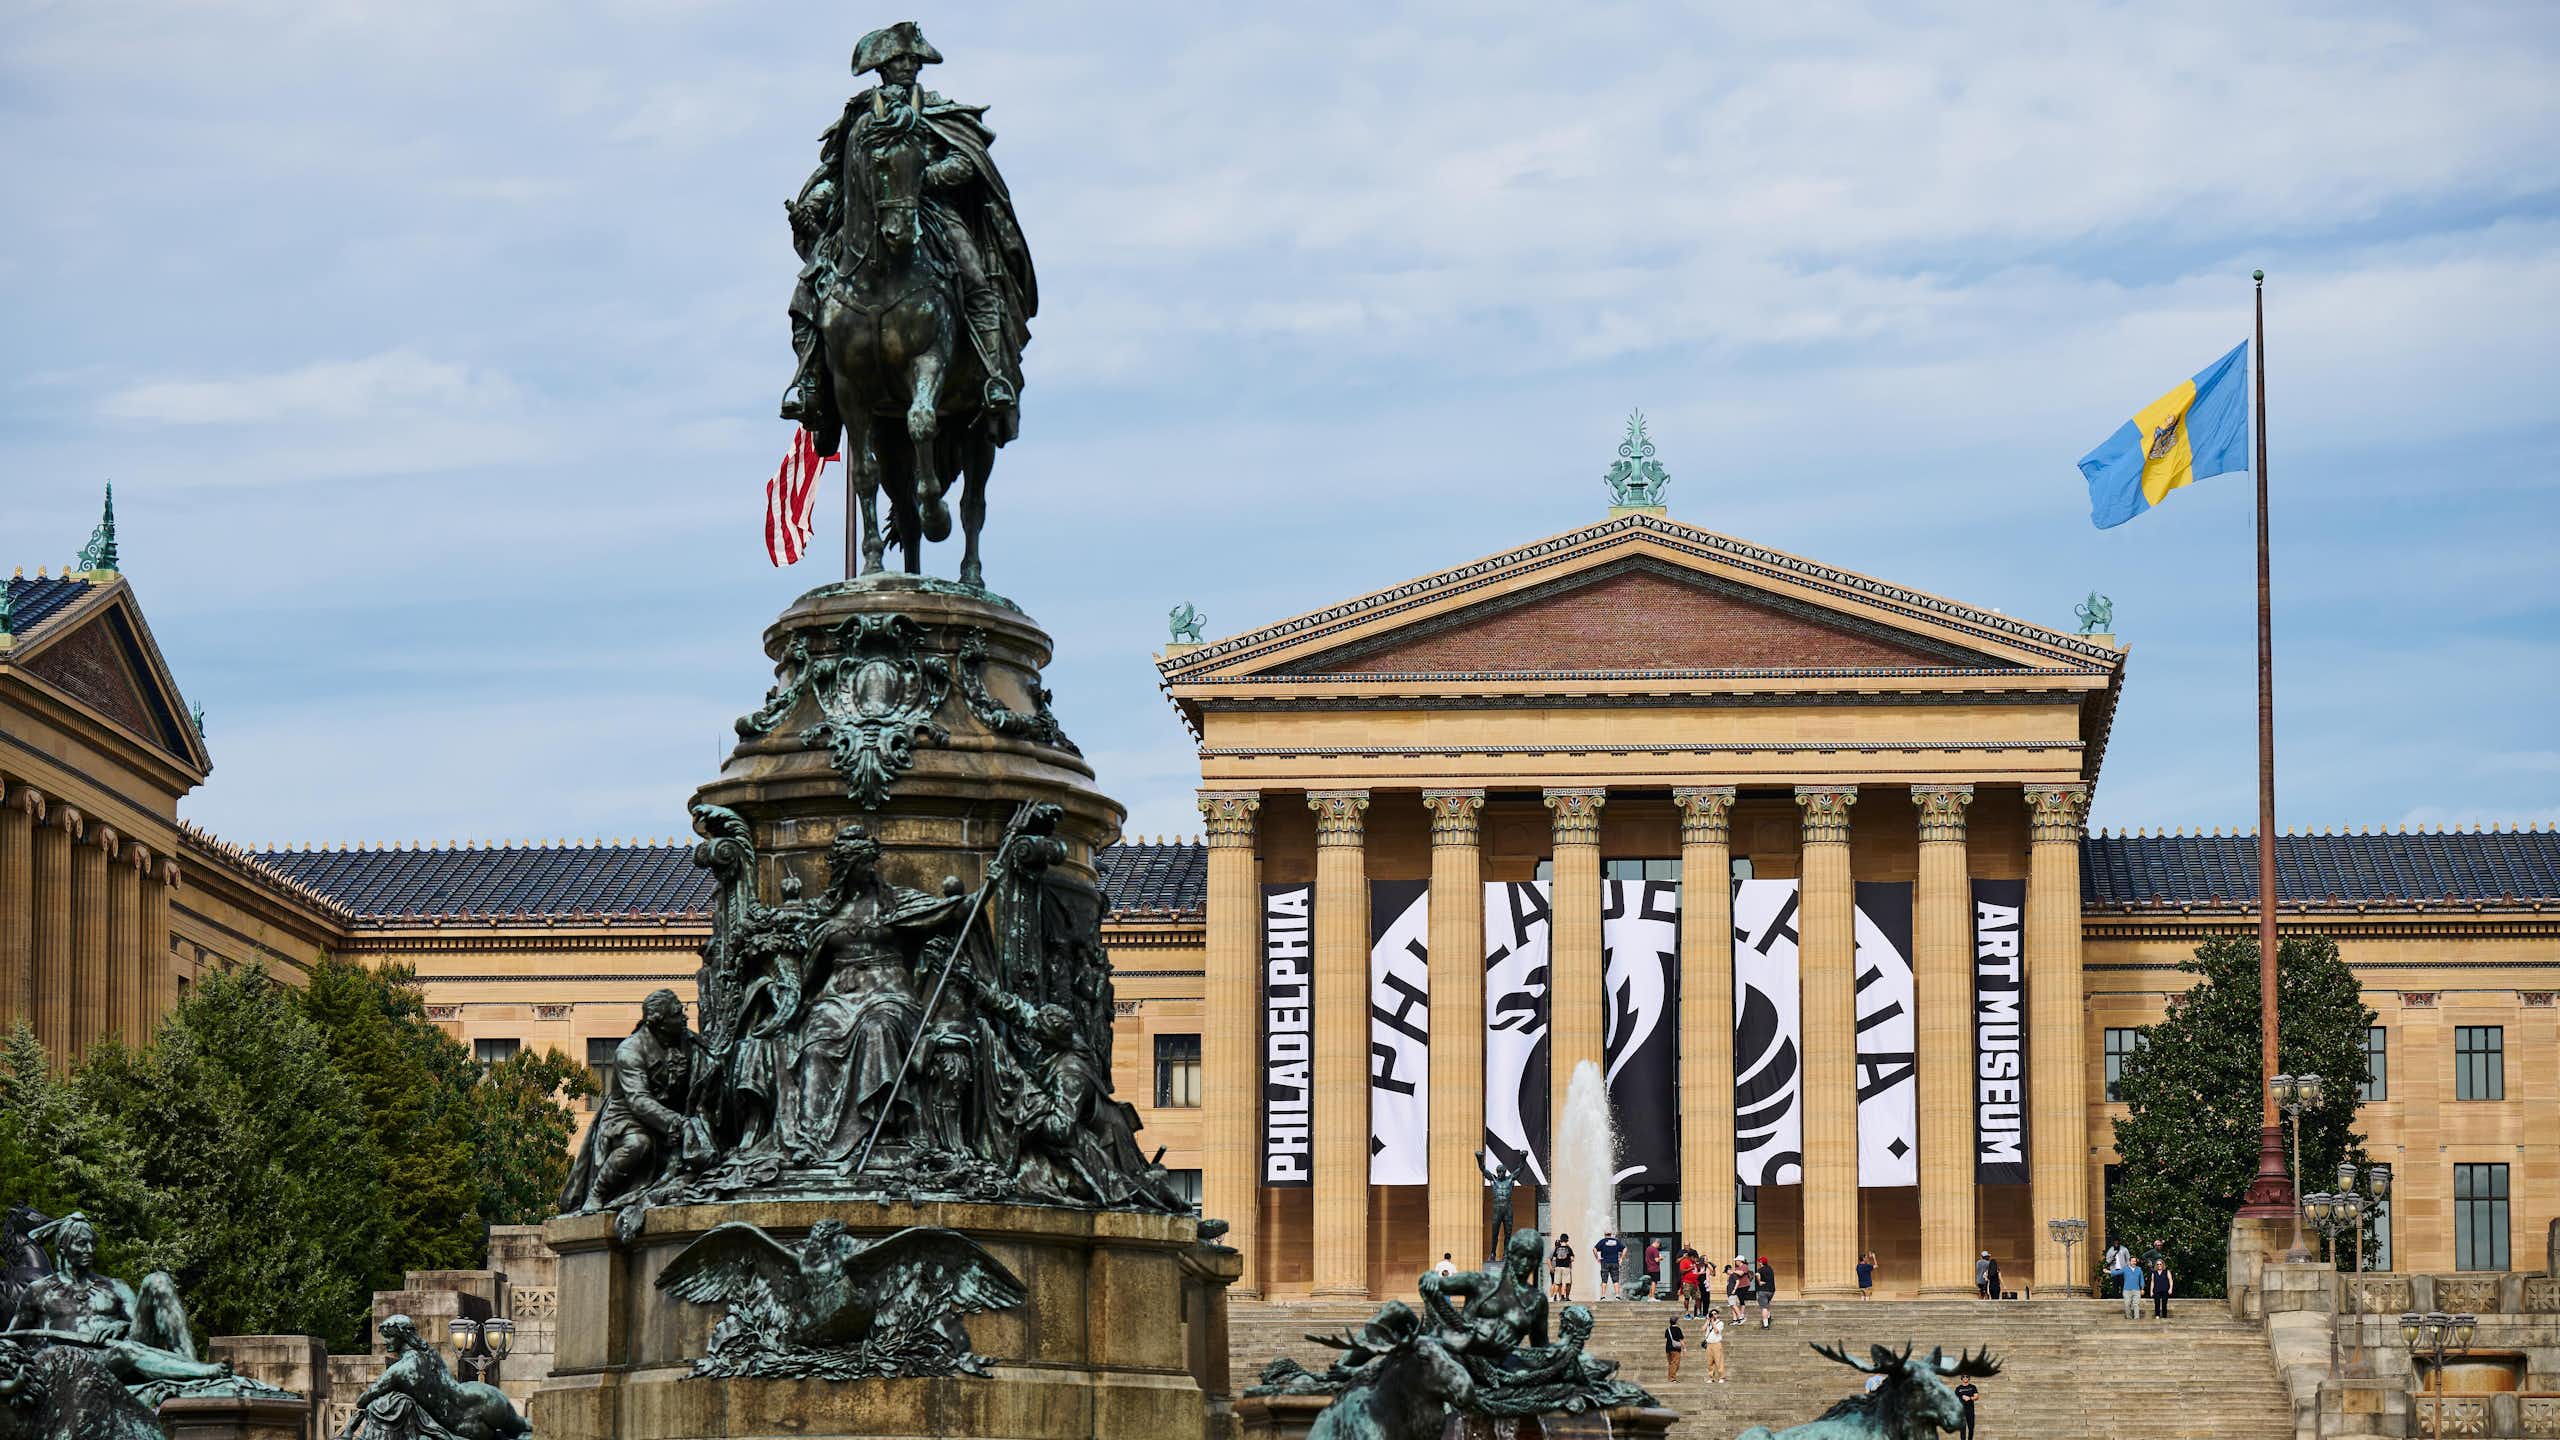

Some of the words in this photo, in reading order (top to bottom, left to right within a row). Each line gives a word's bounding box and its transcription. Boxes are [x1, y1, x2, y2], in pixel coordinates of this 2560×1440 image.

[1977, 900, 2019, 984] ART
[1267, 887, 1309, 1182] PHILADELPHIA
[1979, 989, 2022, 1165] MUSEUM
